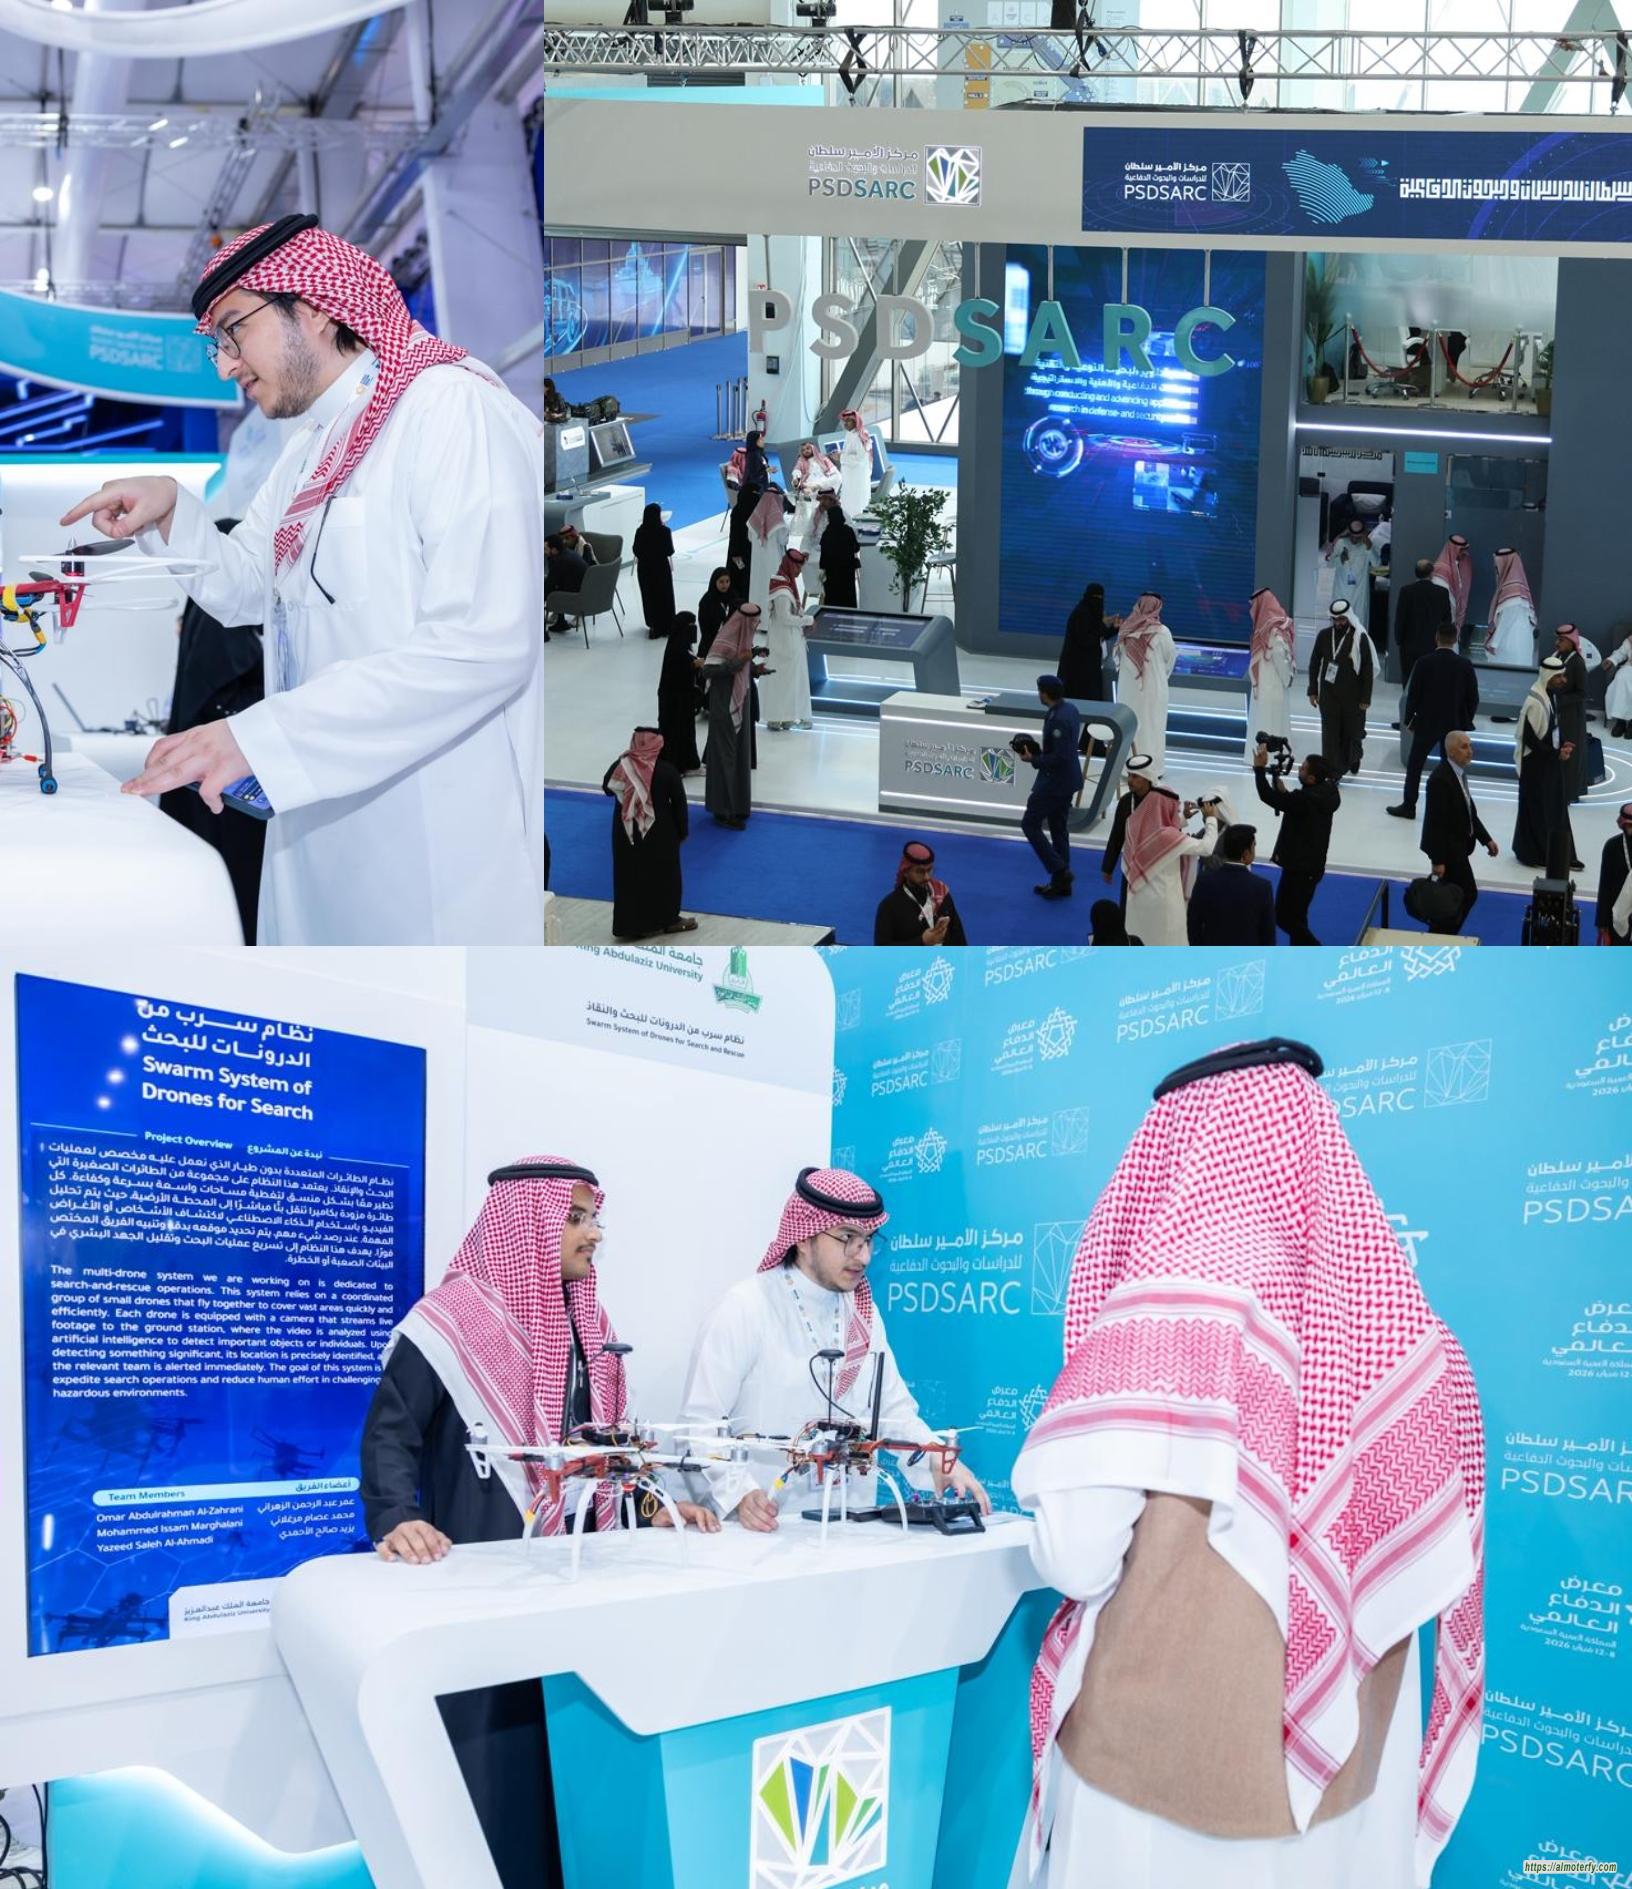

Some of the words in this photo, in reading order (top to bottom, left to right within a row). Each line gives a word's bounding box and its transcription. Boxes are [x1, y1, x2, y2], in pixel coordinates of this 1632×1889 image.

[808, 144, 845, 157] سلطان
[848, 144, 884, 159] الأمير
[887, 147, 918, 160] مركز
[1125, 162, 1153, 171] سلطان
[1155, 162, 1182, 172] الأمير
[1183, 162, 1207, 172] مركز
[1124, 173, 1151, 182] الدفاعية
[1152, 174, 1177, 183] والبحوث
[1178, 175, 1207, 183] للدراسات
[808, 178, 916, 200] PSDSARC
[1124, 184, 1208, 201] PSDSARC
[748, 289, 1236, 376] PSDSARC
[904, 760, 975, 780] PSDSARC
[603, 947, 654, 968] Abdulaziz
[656, 961, 703, 982] University
[985, 949, 1057, 987] PSDSARC
[1323, 959, 1392, 989] العالمي
[137, 999, 170, 1019] من
[621, 1008, 648, 1023] للبحث
[175, 1010, 258, 1033] سرب
[649, 1017, 685, 1031] الدرونات
[1116, 1004, 1209, 1044] PSDSARC
[141, 1024, 207, 1053] للبحث
[261, 1022, 314, 1043] نظام
[586, 1018, 612, 1029] Swarm
[613, 1022, 639, 1035] System
[650, 1031, 674, 1043] Drones
[675, 1037, 685, 1045] for
[687, 1040, 709, 1050] Search
[710, 1045, 722, 1053] and
[687, 1026, 700, 1035] من
[701, 1030, 723, 1041] سرب
[724, 1034, 744, 1045] نظام
[211, 1038, 311, 1068] الدرونات
[1337, 1059, 1377, 1078] الأمير
[1381, 1055, 1418, 1071] مركز
[142, 1055, 214, 1081] Swarm
[218, 1067, 289, 1092] System
[292, 1080, 313, 1095] of
[871, 1070, 928, 1097] PSDSARC
[1371, 1070, 1417, 1086] للدراسات
[1593, 1085, 1619, 1096] 2026
[142, 1081, 214, 1107] Drones
[217, 1093, 247, 1112] for
[250, 1098, 314, 1120] Search
[145, 1131, 182, 1144] Project
[185, 1136, 233, 1149] Overview
[247, 1144, 289, 1155] المشروع
[290, 1149, 304, 1158] عن
[976, 1141, 1048, 1166] PSDSARC
[1528, 1160, 1582, 1177] سلطان
[1526, 1178, 1576, 1194] الدفاعية
[1580, 1176, 1630, 1192] والبحوث
[890, 1233, 932, 1250] سلطان
[935, 1228, 978, 1250] الأمير
[981, 1228, 1023, 1248] مركز
[890, 1257, 928, 1272] الدفاعية
[931, 1256, 968, 1274] والبحوث
[972, 1254, 1023, 1273] للدراسات
[50, 1265, 72, 1274] The
[83, 1267, 146, 1278] multi-drone
[156, 1271, 193, 1282] system
[251, 1276, 289, 1286] working
[333, 1280, 376, 1289] dedicated
[51, 1279, 150, 1291] search-and-rescue
[156, 1284, 214, 1295] operations.
[220, 1286, 240, 1295] This
[246, 1289, 280, 1298] system
[285, 1289, 309, 1298] relies
[341, 1292, 393, 1302] coordinated
[888, 1281, 1021, 1314] PSDSARC
[1568, 1367, 1594, 1378] 2026
[991, 1385, 1018, 1396] معرض
[987, 1397, 1017, 1408] الدفاع
[978, 1410, 1017, 1421] العالمي
[1506, 1432, 1558, 1447] سلطان
[1562, 1437, 1616, 1453] الأمير
[1504, 1451, 1552, 1464] الدفاعية
[1556, 1456, 1604, 1473] والبحوث
[109, 1492, 136, 1502] Team
[139, 1490, 186, 1501] Members
[96, 1513, 125, 1523] Omar
[128, 1508, 195, 1521] Abdulrahman
[197, 1505, 244, 1516] Al-Zahrani
[96, 1525, 159, 1538] Mohammed
[160, 1523, 190, 1533] Issam
[191, 1520, 244, 1533] Marghalani
[96, 1542, 133, 1553] Yazeed
[135, 1539, 163, 1550] Saleh
[164, 1535, 214, 1548] Al-Ahmadi
[1560, 1575, 1623, 1597] معرض
[1548, 1593, 1620, 1615] الدفاع
[1529, 1611, 1619, 1634] العالمي
[1545, 1637, 1570, 1649] 2026
[1484, 1690, 1536, 1711] سلطان
[1539, 1704, 1592, 1726] الأمير
[1534, 1719, 1580, 1742] والبحوث
